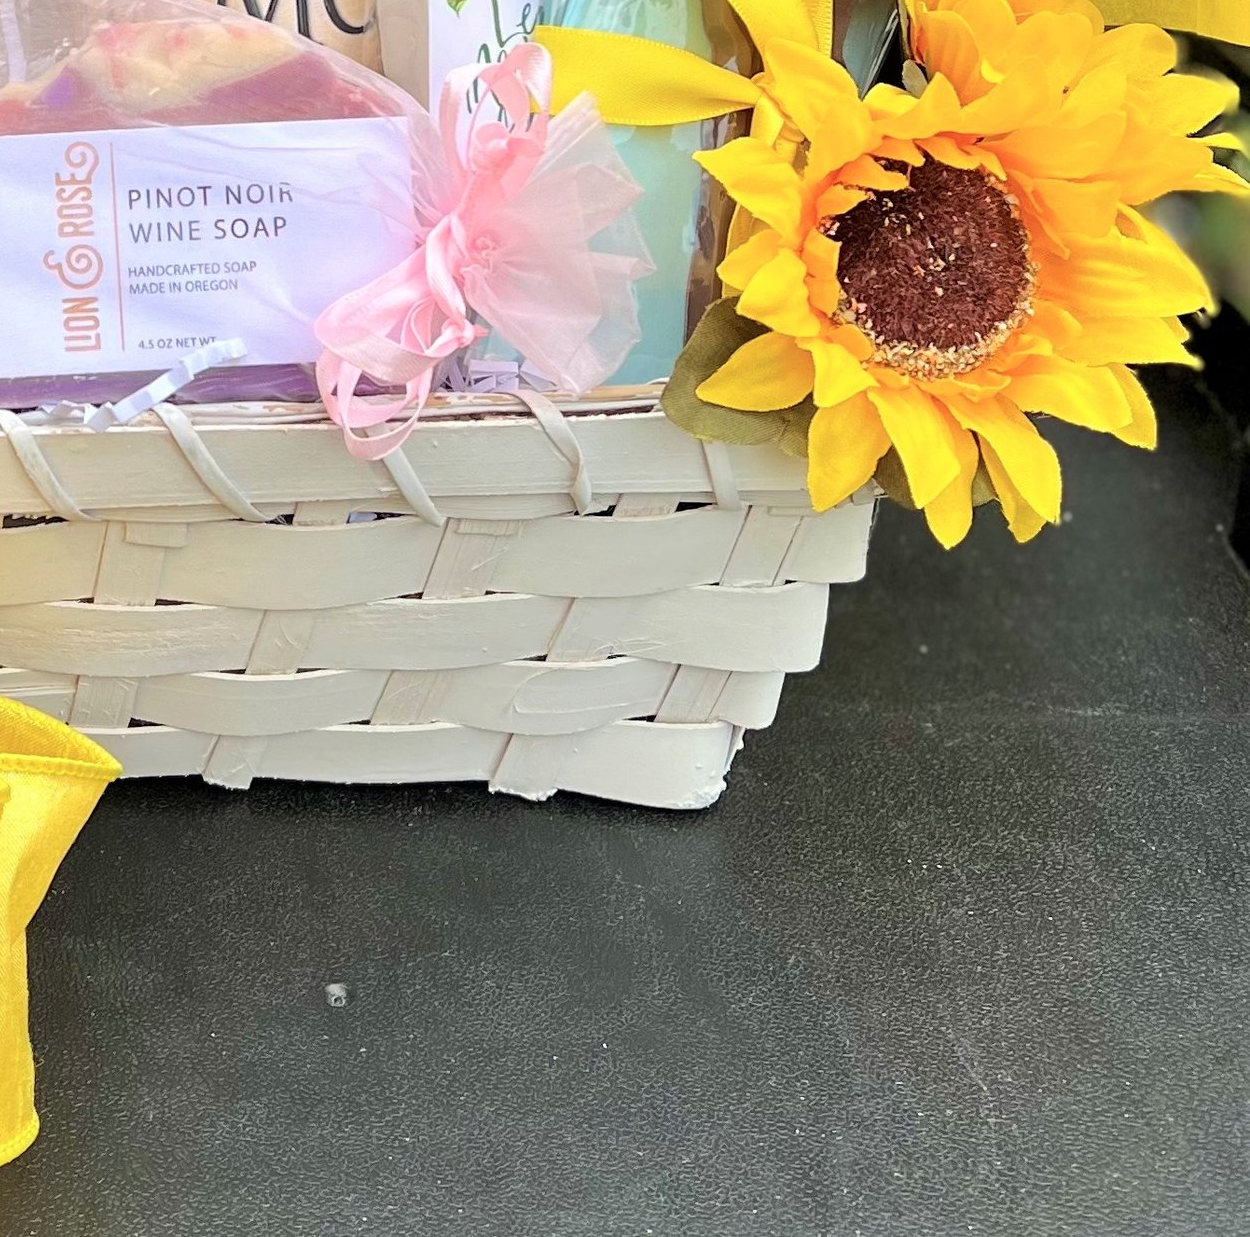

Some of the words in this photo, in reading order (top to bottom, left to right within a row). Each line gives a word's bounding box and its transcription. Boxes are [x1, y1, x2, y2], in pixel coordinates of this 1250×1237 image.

[54, 141, 100, 239] ROSE
[128, 185, 213, 211] PINOT
[225, 181, 294, 205] NOIR
[129, 220, 202, 244] WINE
[214, 216, 288, 241] SOAP
[128, 263, 221, 278] HANDCRAFTED
[224, 260, 258, 274] SOAP
[129, 282, 166, 295] MADE
[169, 280, 182, 293] IN
[185, 278, 239, 292] OREGON
[62, 296, 102, 352] LION
[138, 339, 154, 350] 4.5
[157, 338, 173, 350] OZ
[176, 337, 196, 349] NET
